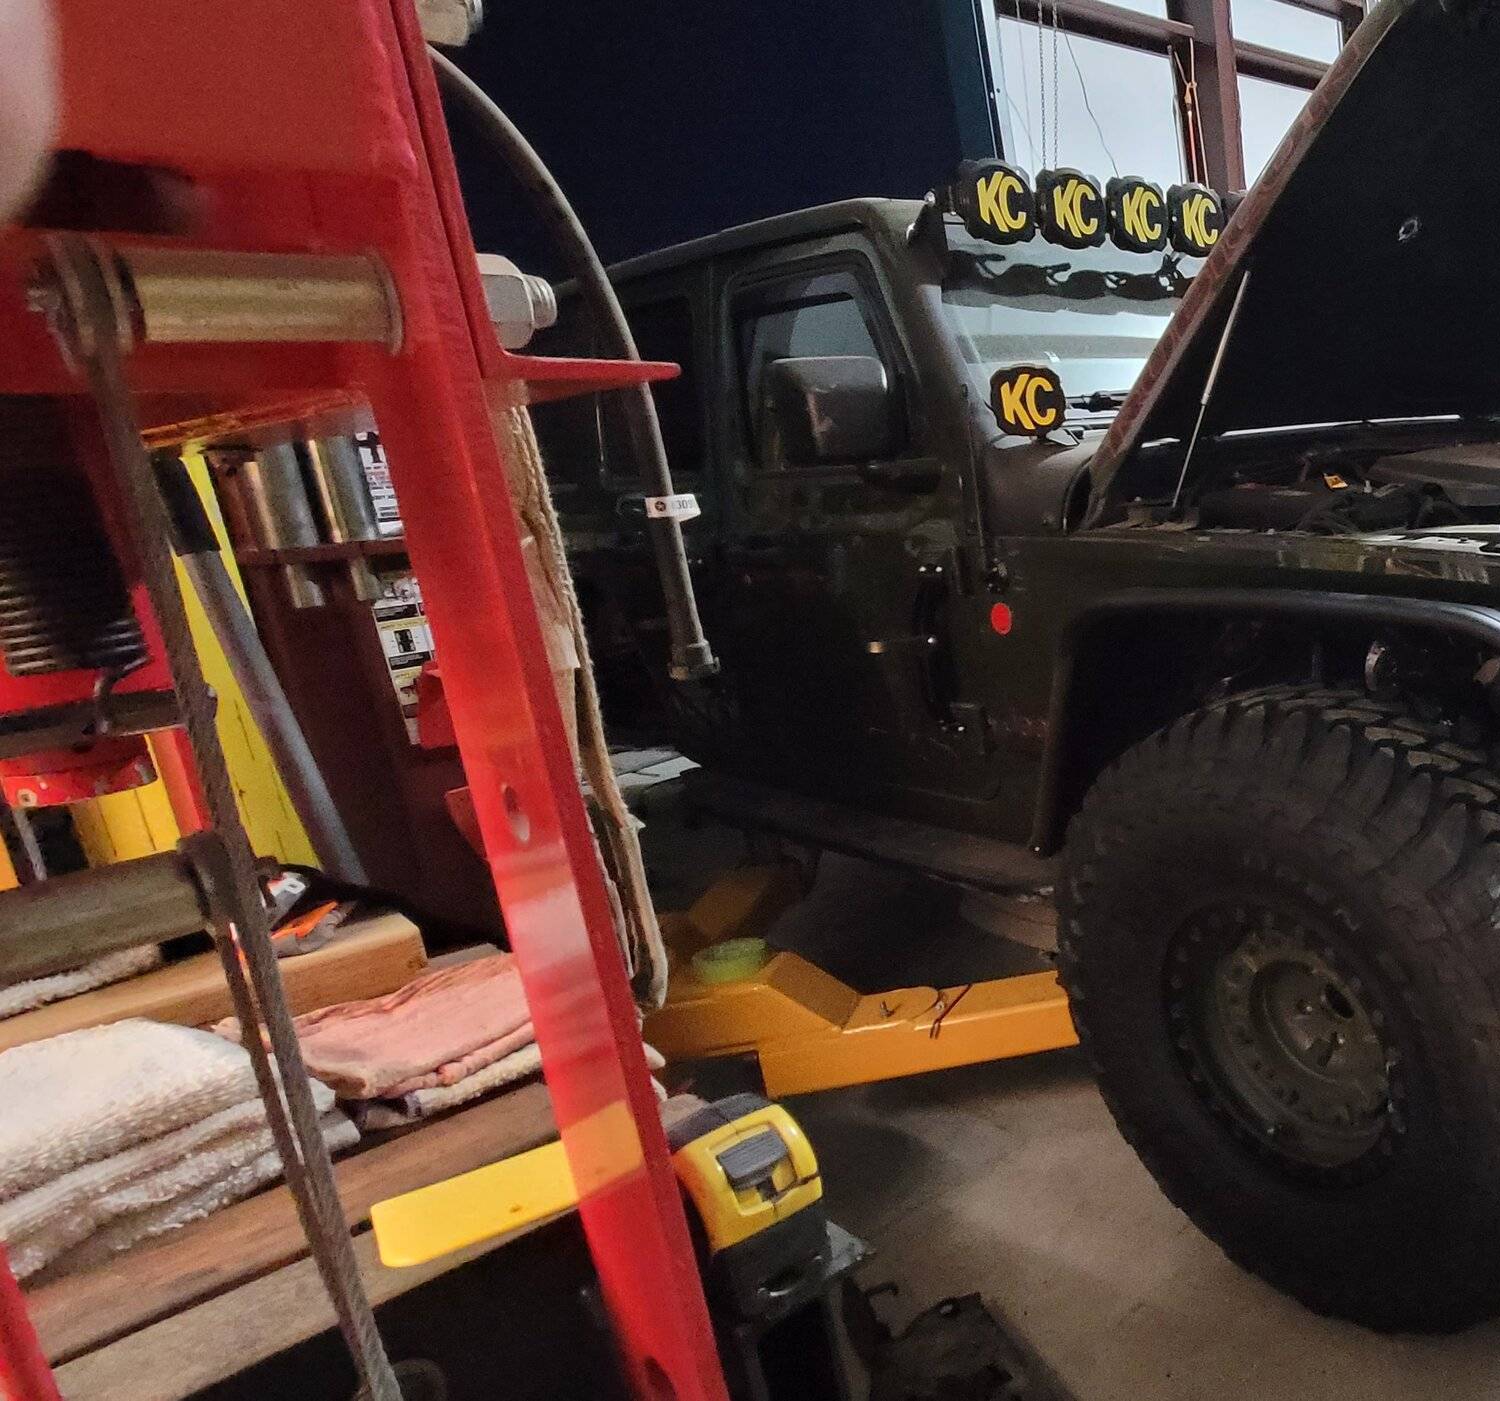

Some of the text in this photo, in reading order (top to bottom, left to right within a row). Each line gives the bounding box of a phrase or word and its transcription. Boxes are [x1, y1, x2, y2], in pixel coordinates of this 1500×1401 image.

[977, 171, 1026, 233] KC
[1054, 179, 1098, 238] KC
[1123, 187, 1162, 243] KC
[1183, 194, 1218, 247] KC
[1001, 374, 1056, 430] KC
